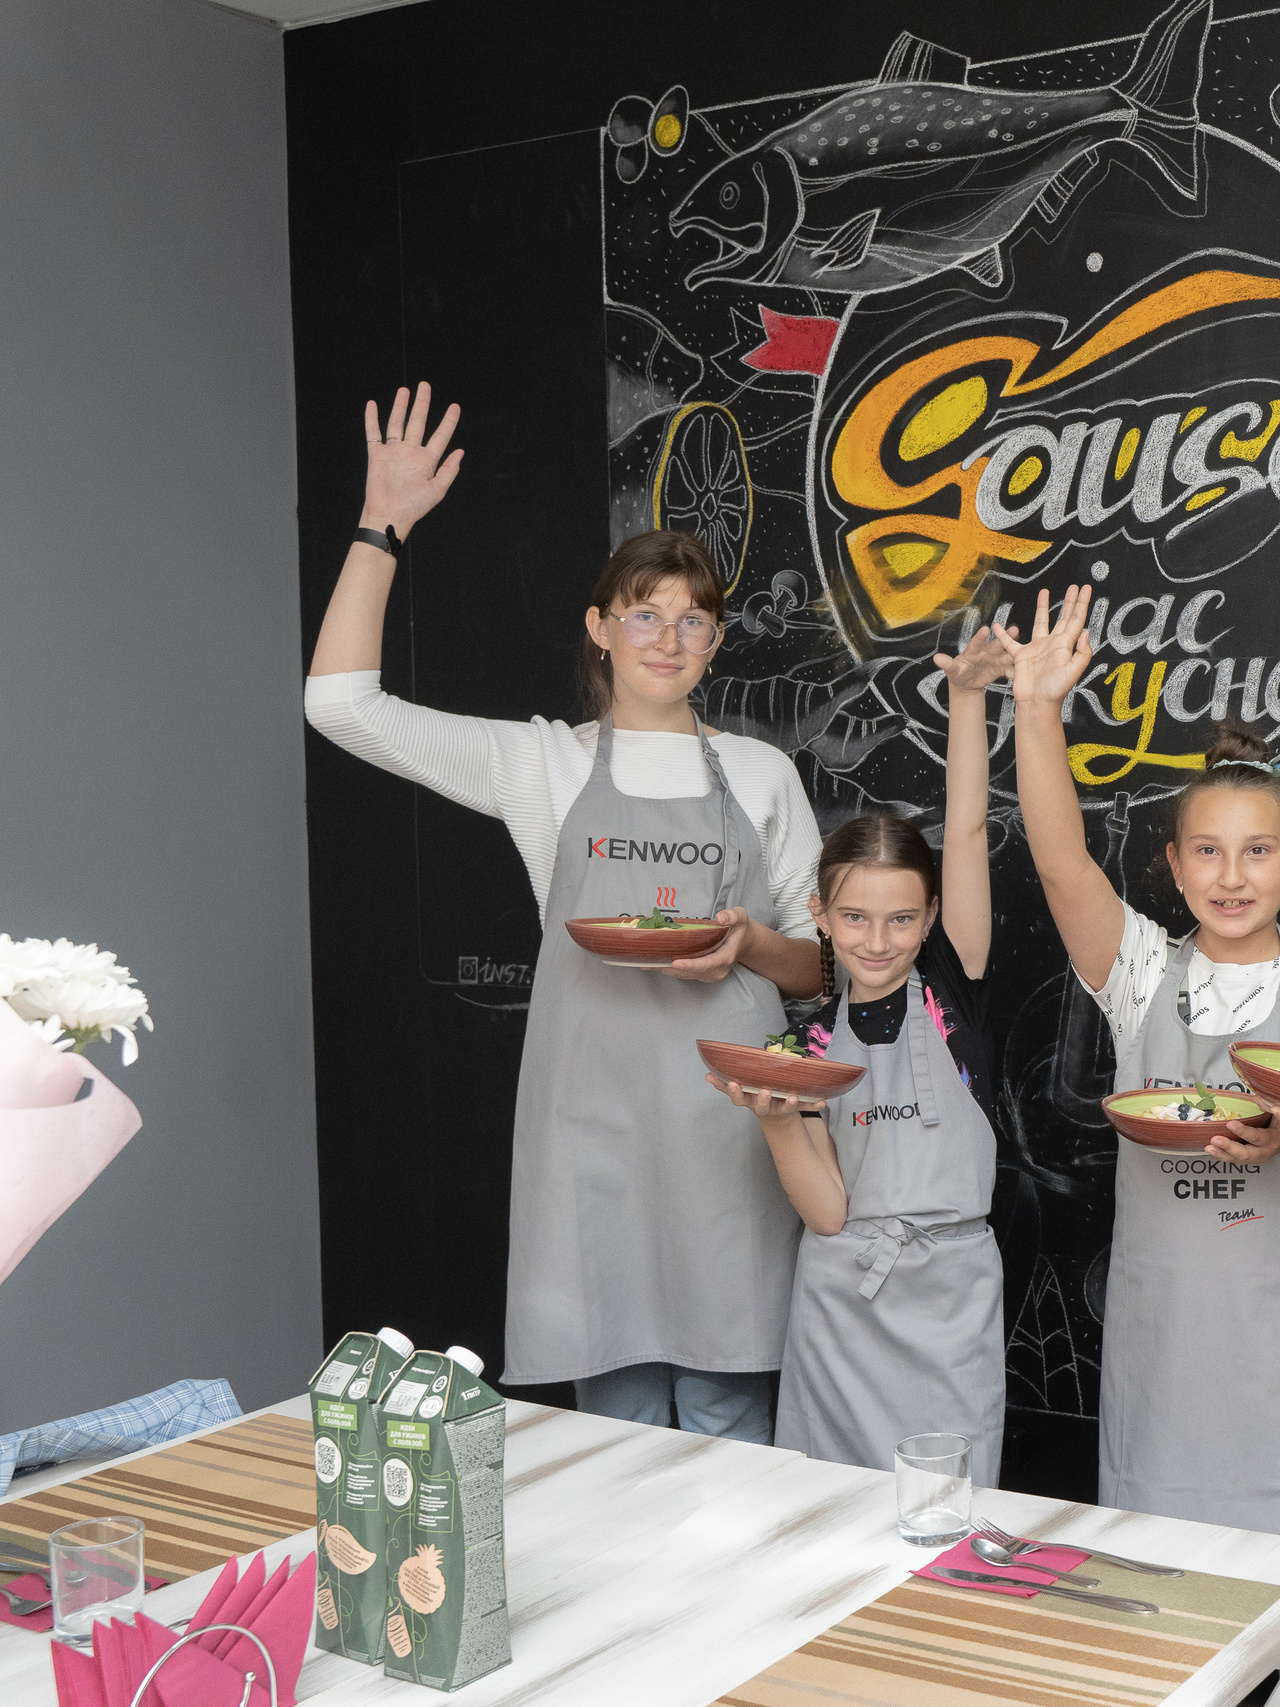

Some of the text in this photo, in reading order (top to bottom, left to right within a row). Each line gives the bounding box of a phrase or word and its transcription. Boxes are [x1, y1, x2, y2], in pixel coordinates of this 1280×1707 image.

[588, 837, 741, 866] KENWOO
[1160, 1159, 1261, 1174] COOKING
[1173, 1179, 1246, 1200] CHEF
[1218, 1208, 1256, 1223] Team
